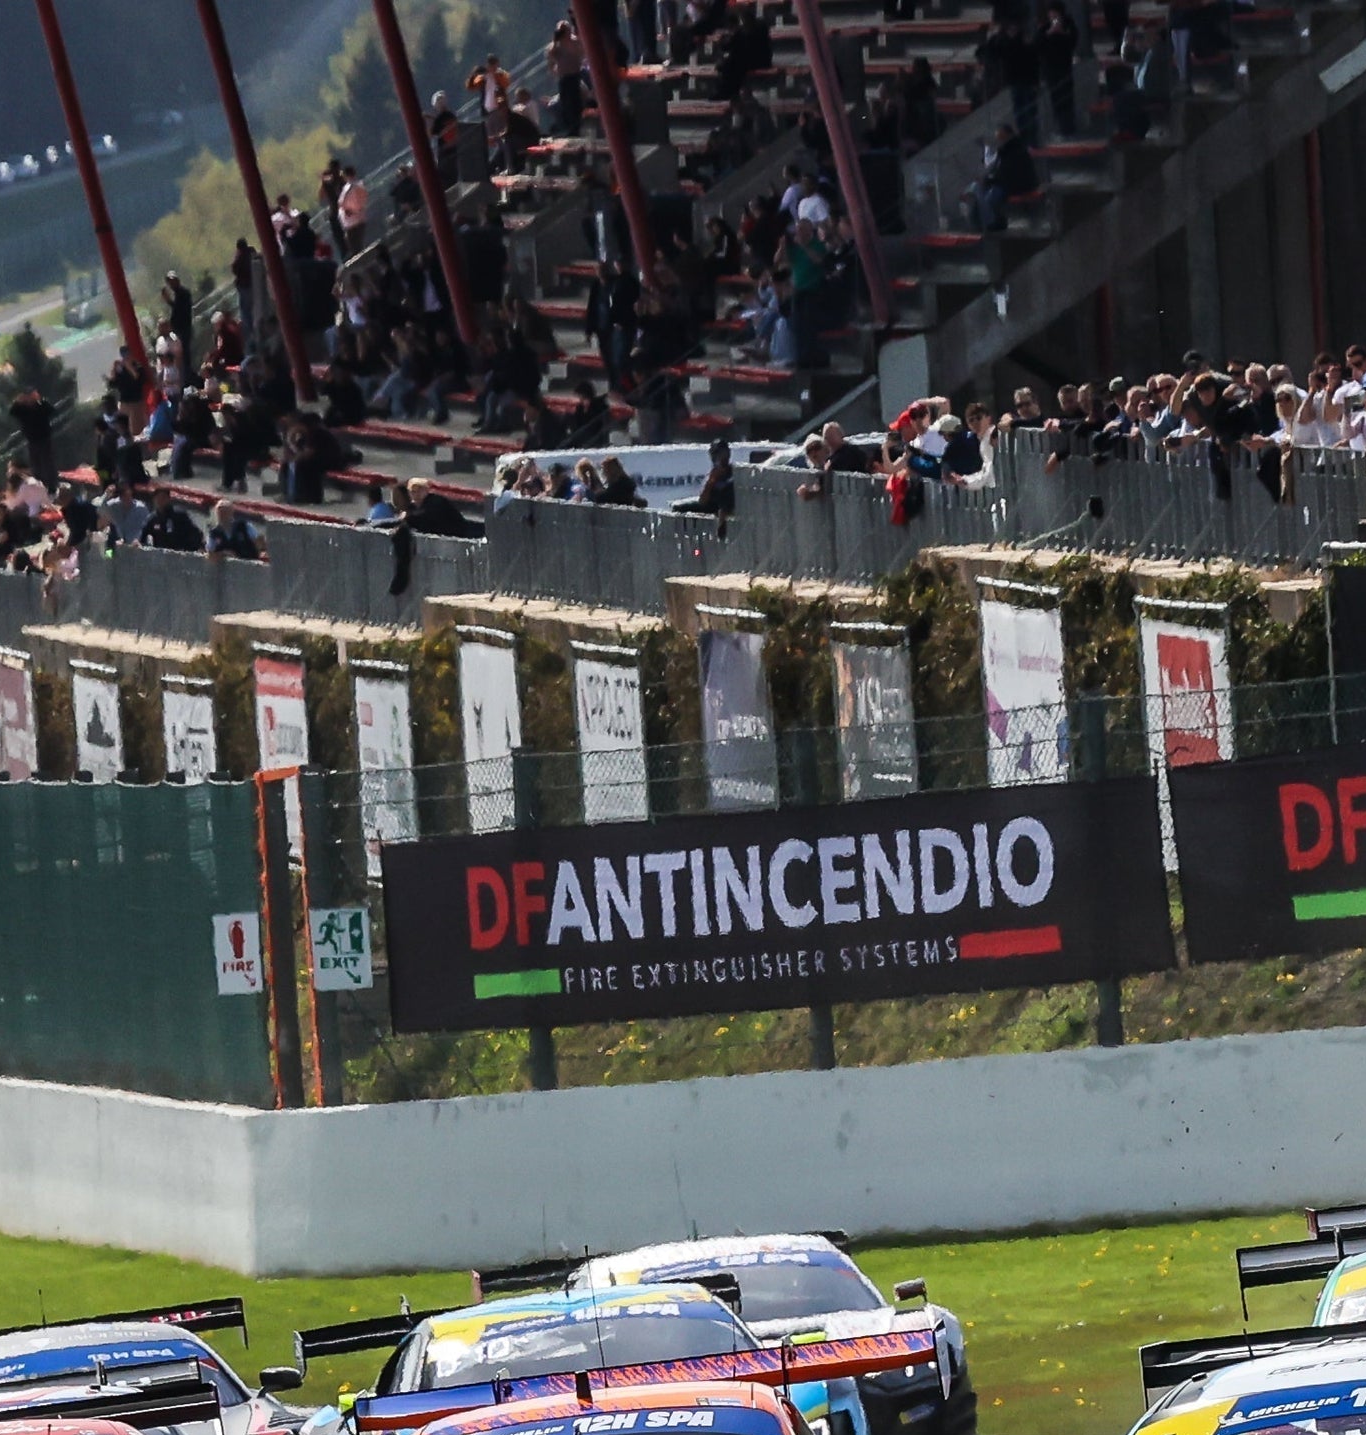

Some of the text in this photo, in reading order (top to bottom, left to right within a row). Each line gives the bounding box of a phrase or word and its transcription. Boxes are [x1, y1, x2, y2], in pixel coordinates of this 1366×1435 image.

[465, 815, 1055, 952] DFANTINCENDIO
[320, 957, 360, 971] EXIT
[563, 936, 959, 995] FIRE EXTINGUISHER SYSTEMS
[1247, 1395, 1340, 1419] MICHELIN
[573, 1411, 636, 1434] 12H
[643, 1410, 715, 1430] SPA
